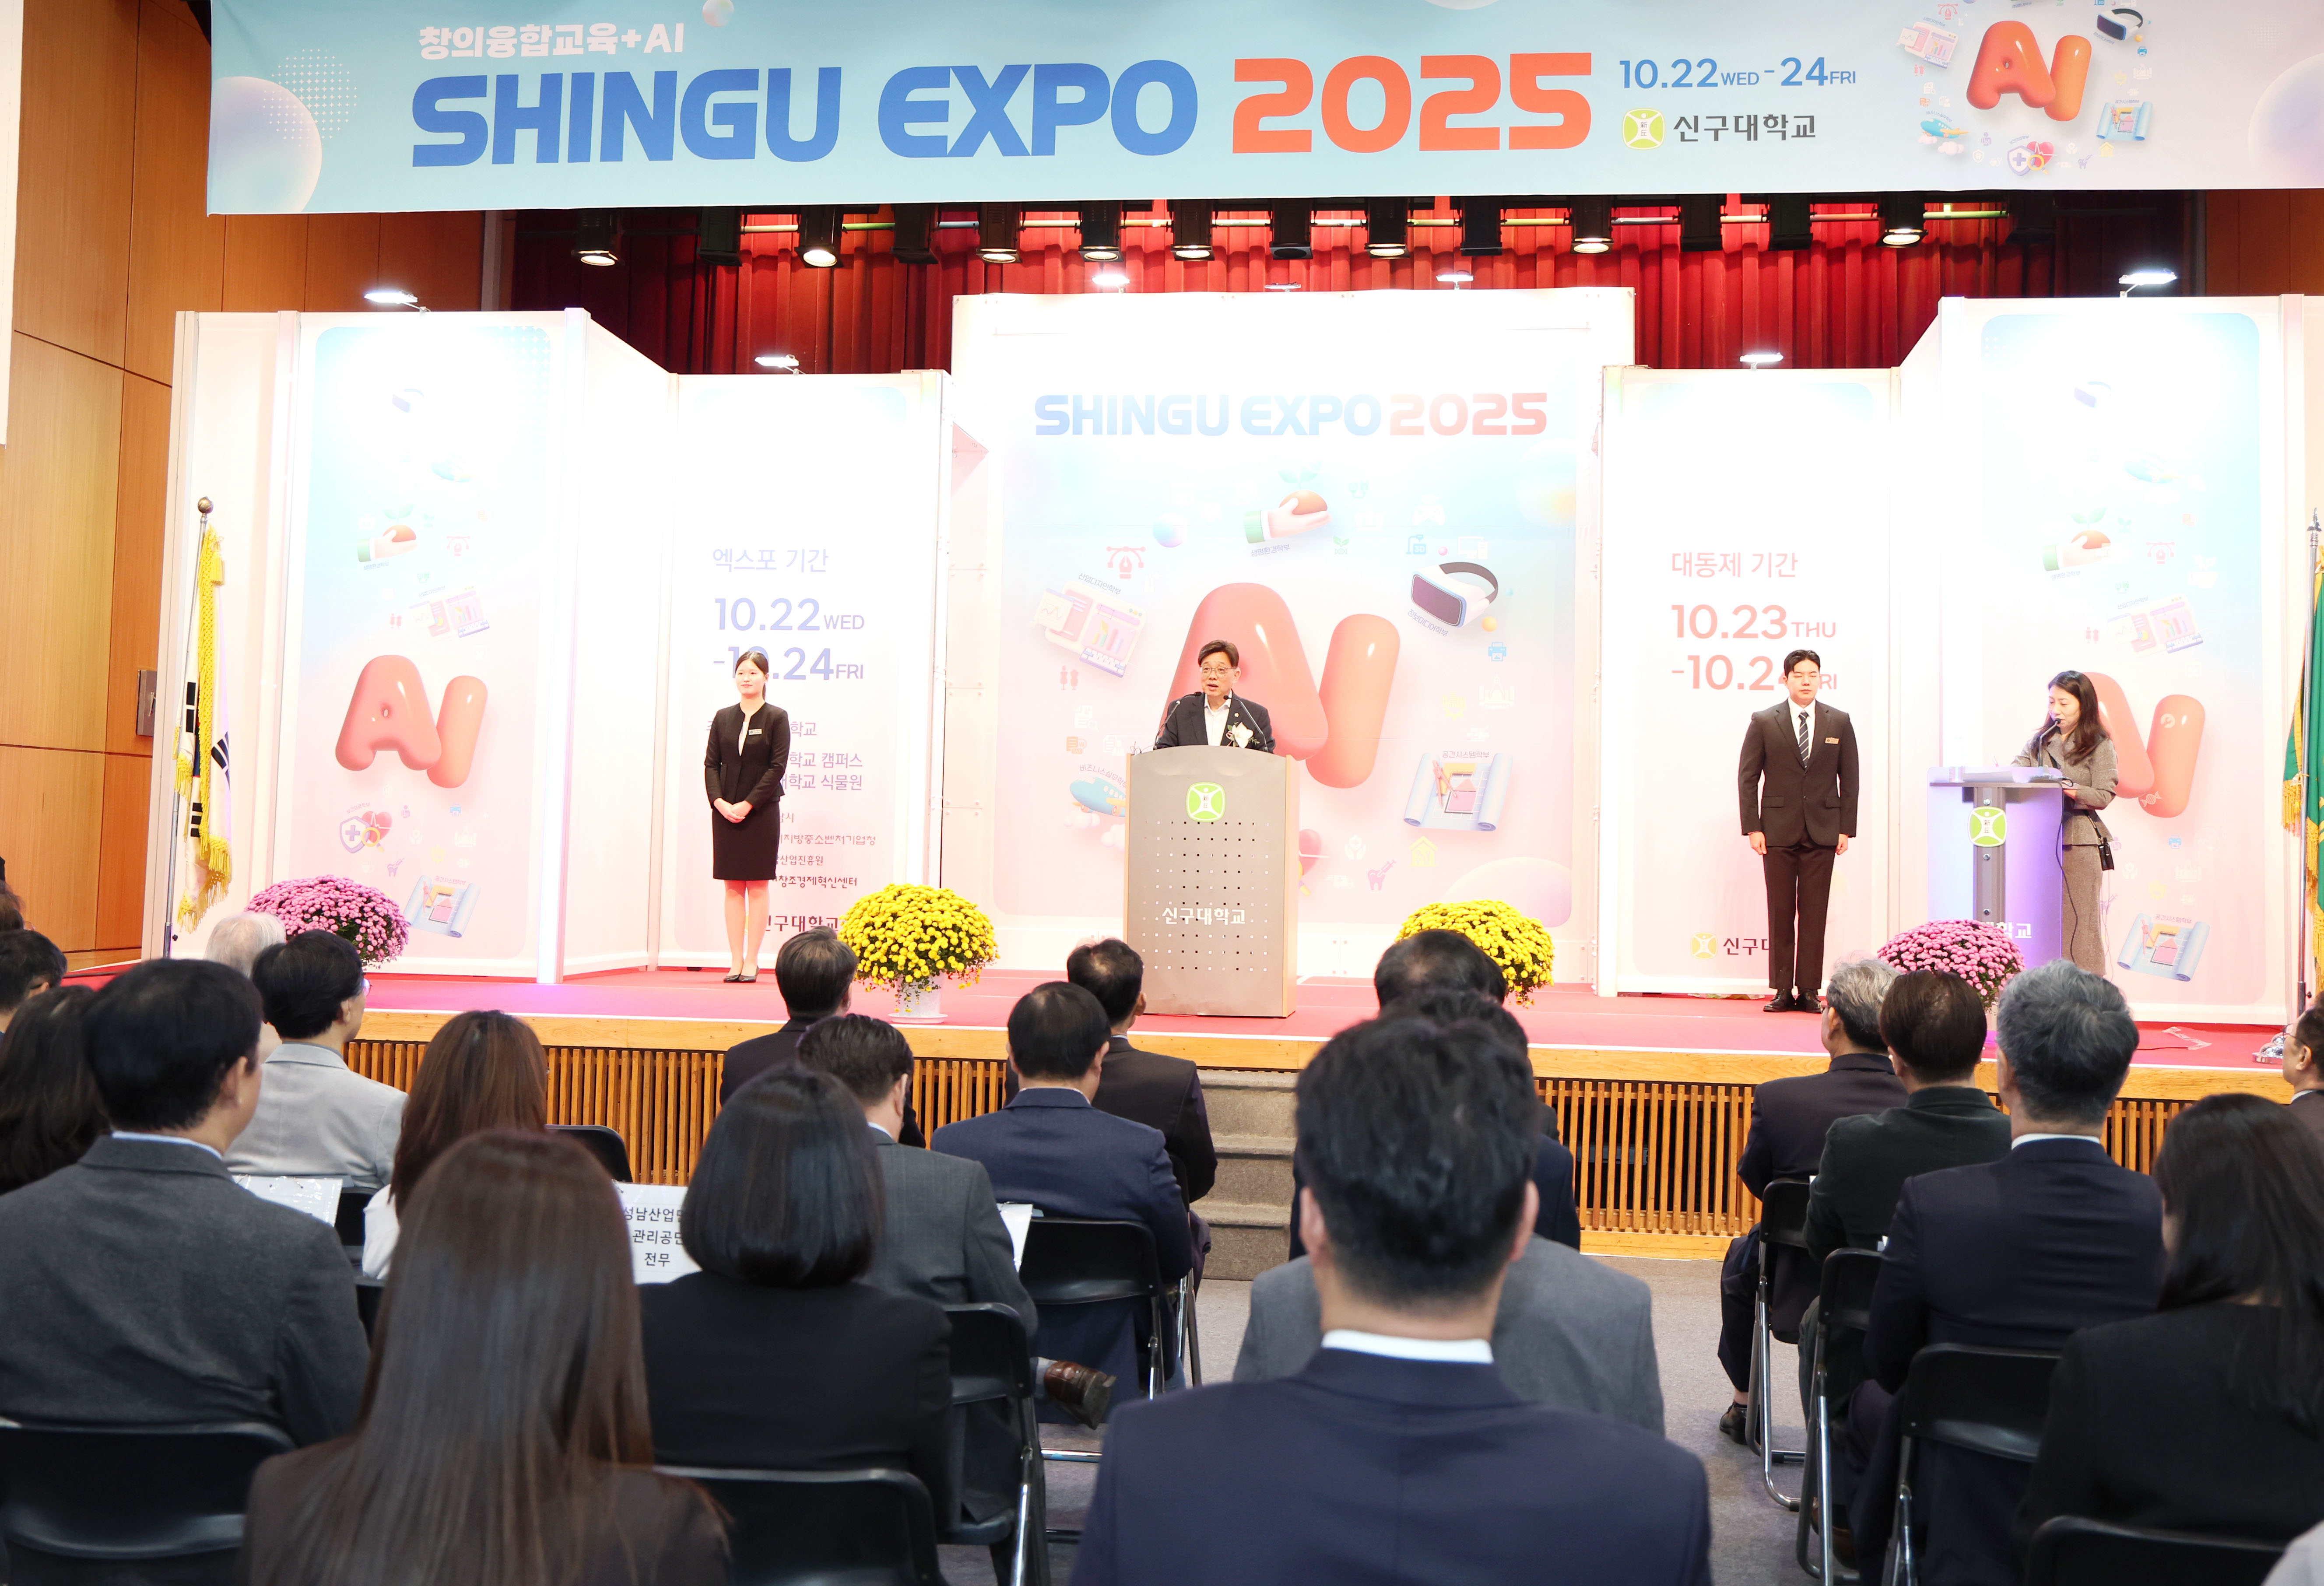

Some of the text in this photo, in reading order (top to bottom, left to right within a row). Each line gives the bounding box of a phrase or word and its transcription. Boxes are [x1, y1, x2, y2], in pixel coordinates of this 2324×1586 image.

[420, 23, 684, 60] 창의융합교육+AI
[1967, 21, 2092, 122] AI
[413, 53, 1592, 167] SHINGU EXPO 2025
[1674, 115, 1816, 142] 신구대학교
[1036, 393, 1548, 436] SHINGU EXPO 2025
[713, 549, 829, 573] 엑스포 기간
[1250, 543, 1290, 557] 생명환경학부
[1673, 553, 1798, 578] 대동제 기간
[1078, 572, 1121, 595] 산업디자인학부
[1407, 609, 1449, 637] 정보미디어학부
[336, 656, 486, 789] AI
[790, 721, 817, 737] 학교
[789, 752, 863, 768] 학교 캠퍼스
[821, 774, 862, 790] 식물원
[776, 855, 823, 866] 산업진흥원
[773, 875, 857, 889] 창조경제혁신센터
[1162, 907, 1246, 925] 신구대학교
[645, 1253, 671, 1267] 전무
